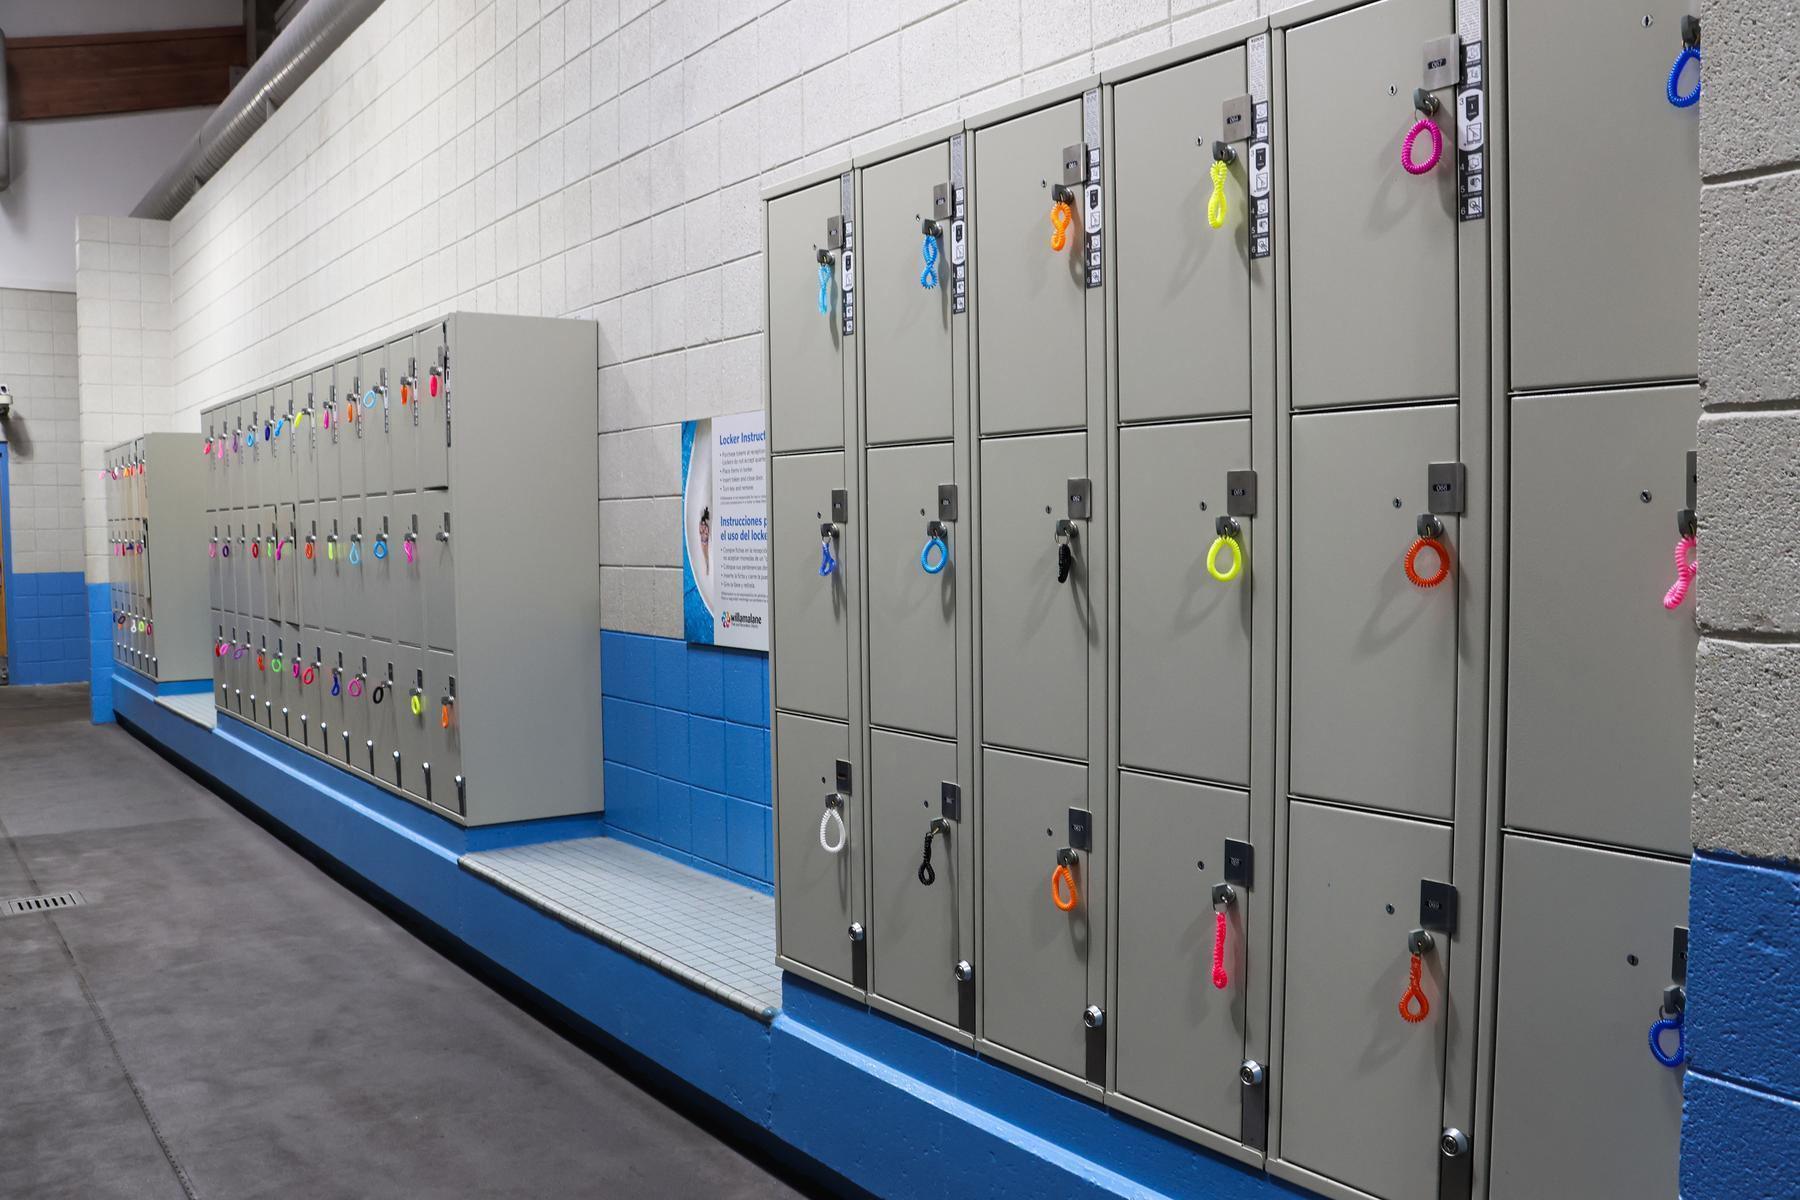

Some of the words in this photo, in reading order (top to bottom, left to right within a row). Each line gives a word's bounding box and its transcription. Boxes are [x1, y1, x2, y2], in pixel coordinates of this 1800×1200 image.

[720, 434, 740, 446] Locker
[721, 514, 762, 527] Instrucciones
[721, 530, 726, 541] el
[728, 532, 738, 541] uso
[740, 530, 750, 541] del
[731, 612, 762, 624] willamalane
